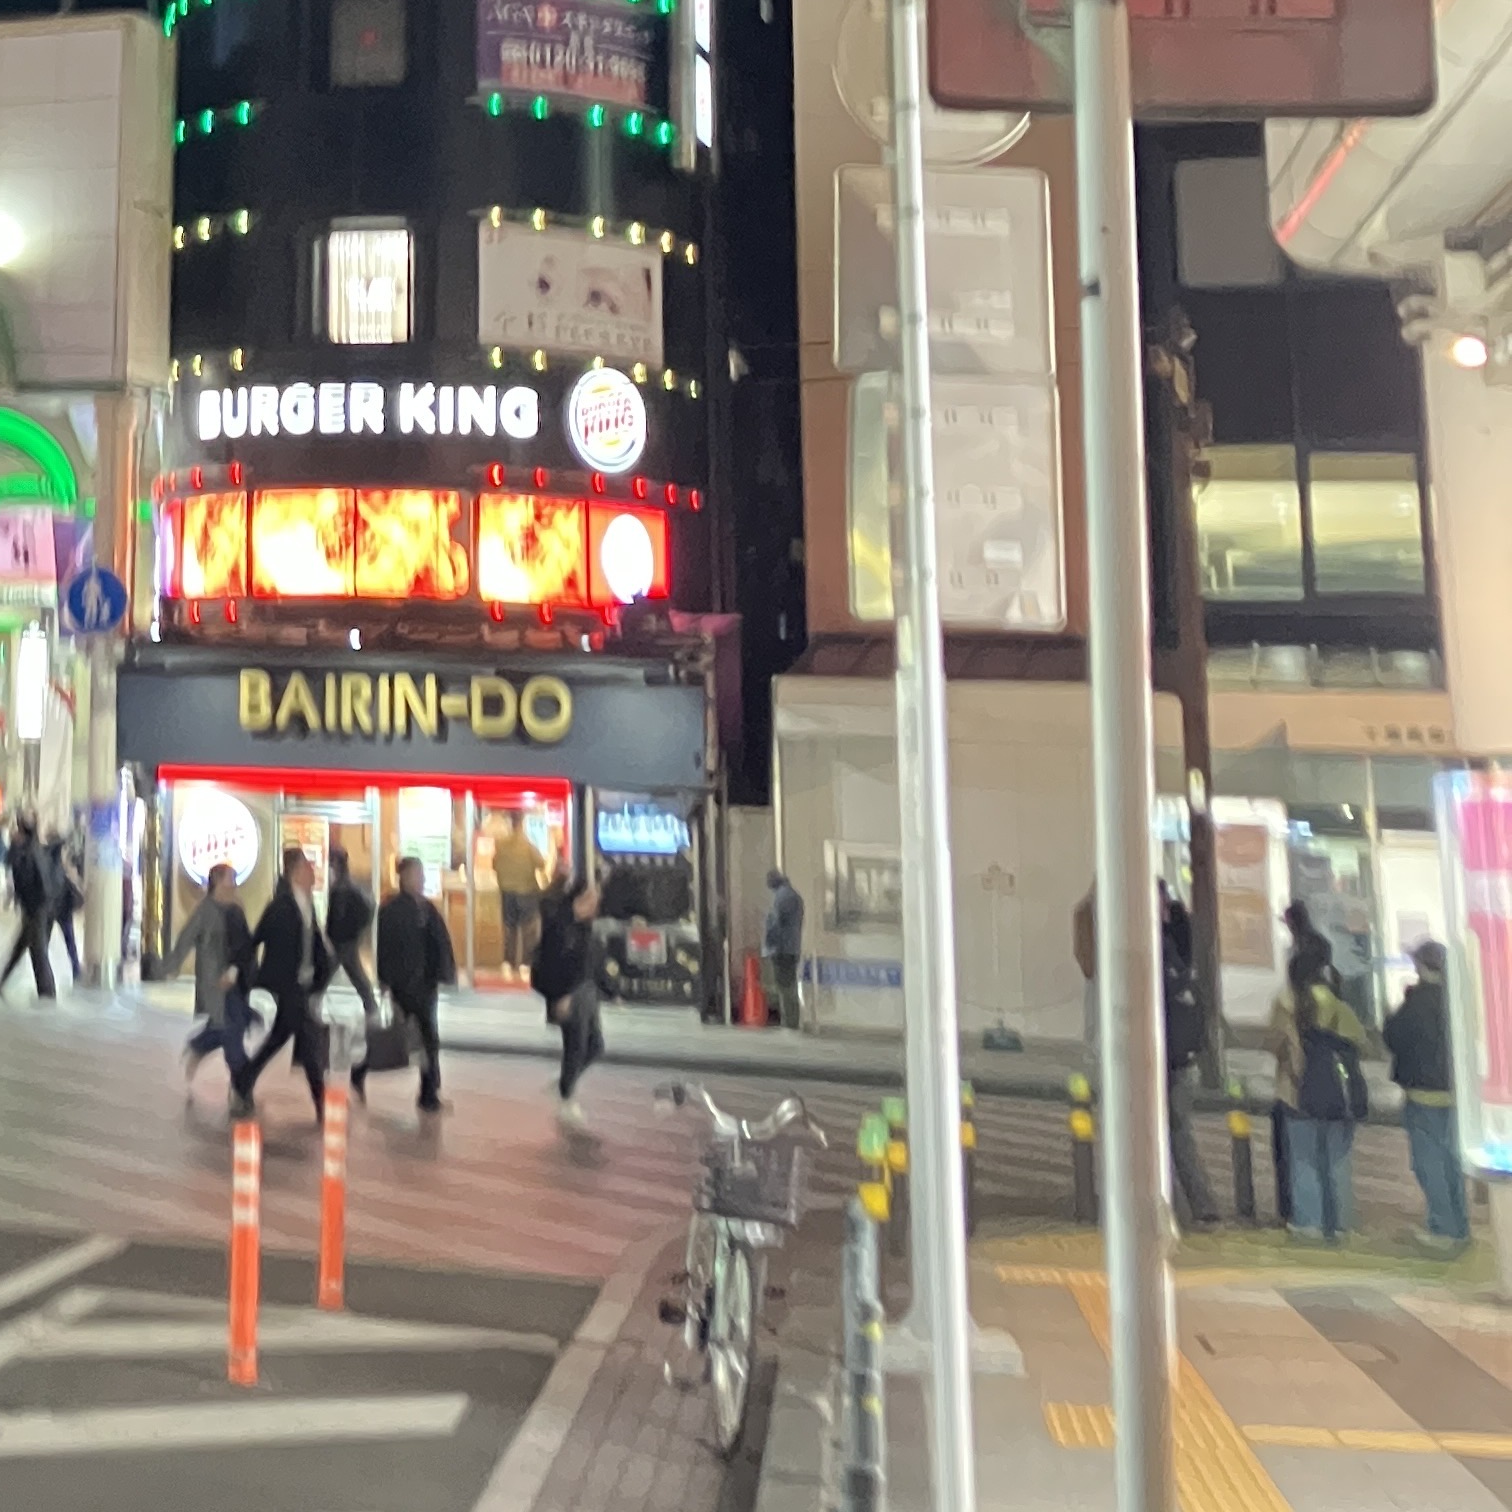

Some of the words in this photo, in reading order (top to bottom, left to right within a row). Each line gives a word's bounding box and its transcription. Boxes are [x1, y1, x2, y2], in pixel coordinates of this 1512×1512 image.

[197, 380, 386, 442] BURGER
[398, 381, 541, 440] KING
[237, 668, 574, 743] BAIRIN-DO
